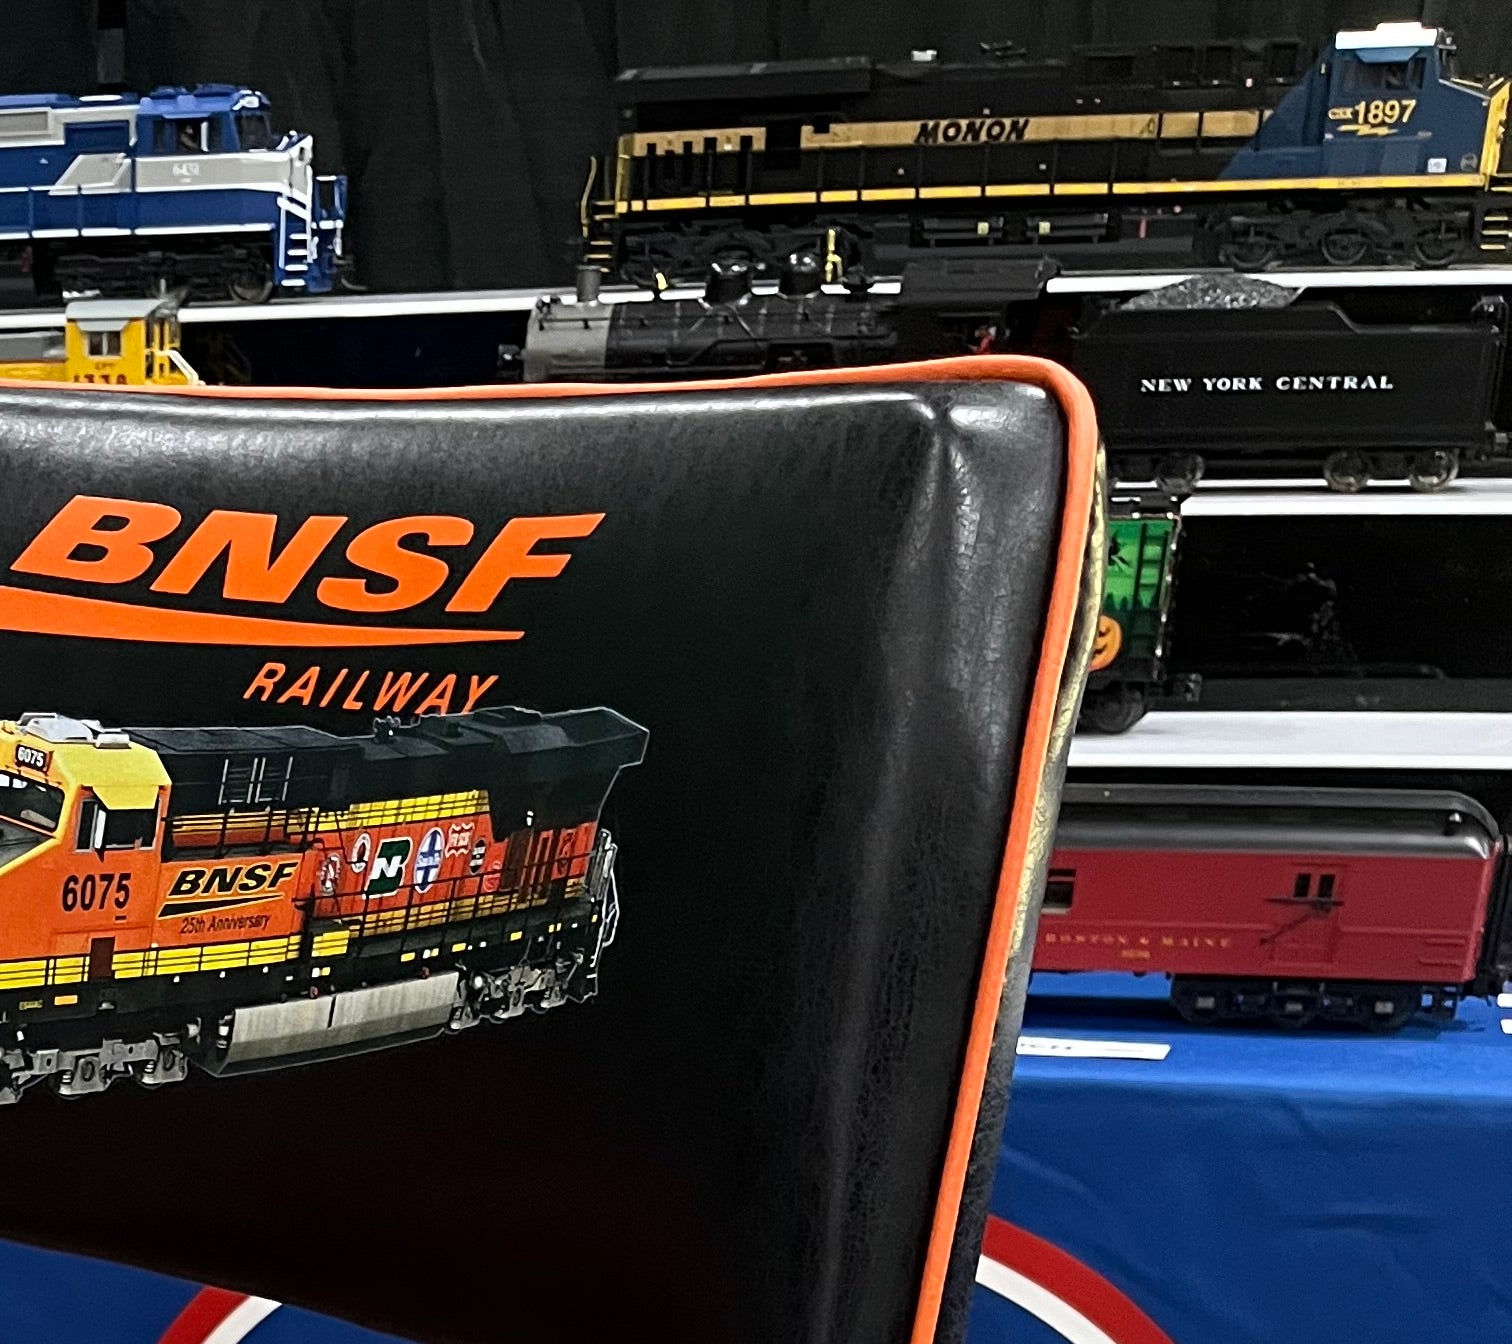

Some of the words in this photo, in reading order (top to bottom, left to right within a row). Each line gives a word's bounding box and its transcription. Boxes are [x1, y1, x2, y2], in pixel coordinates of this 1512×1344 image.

[1355, 99, 1417, 125] 1897
[915, 118, 1030, 144] MONON
[1140, 378, 1192, 392] NEW
[1202, 376, 1263, 391] YORK
[1275, 374, 1394, 390] CENTRAL
[9, 494, 606, 612] BNSF
[243, 661, 498, 714] RAILWAY
[17, 745, 45, 768] 6075
[62, 872, 132, 912] 6075
[168, 861, 299, 897] BNSF
[180, 915, 207, 934] 25th
[207, 913, 272, 933] Anniversary
